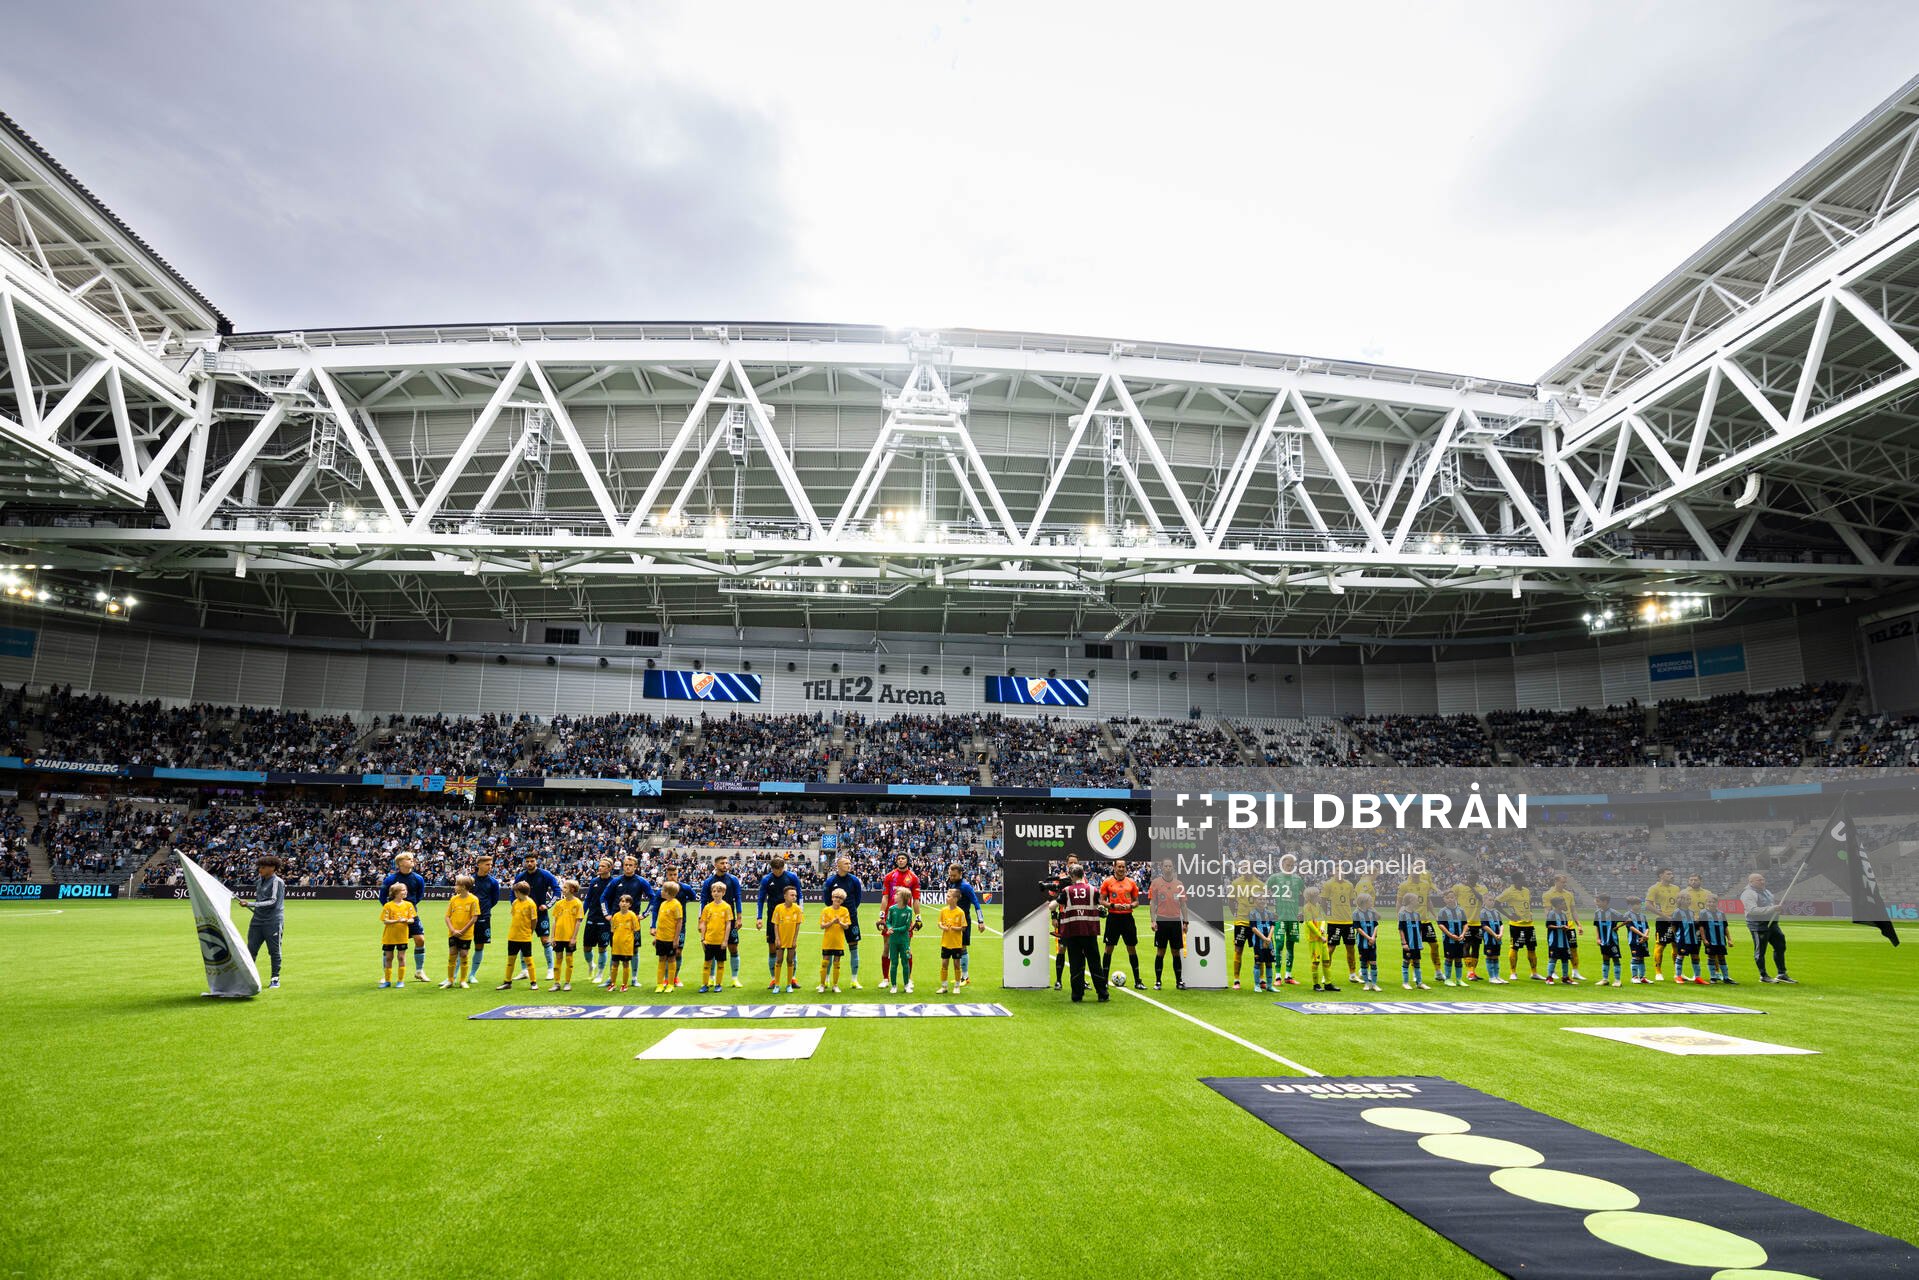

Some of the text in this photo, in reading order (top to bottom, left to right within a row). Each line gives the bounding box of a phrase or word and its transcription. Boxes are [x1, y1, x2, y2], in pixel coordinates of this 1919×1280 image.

[803, 676, 947, 706] TELE2 Arena
[34, 758, 119, 773] SUNDBYBERG
[1015, 824, 1075, 839] UNIBET
[1148, 826, 1206, 841] UNIBET
[0, 884, 42, 896] PROJOB
[58, 884, 112, 899] MOBILL
[1073, 887, 1087, 900] 13
[583, 1003, 999, 1018] ALLSVENSKAN
[1260, 1083, 1423, 1094] UNIBET
